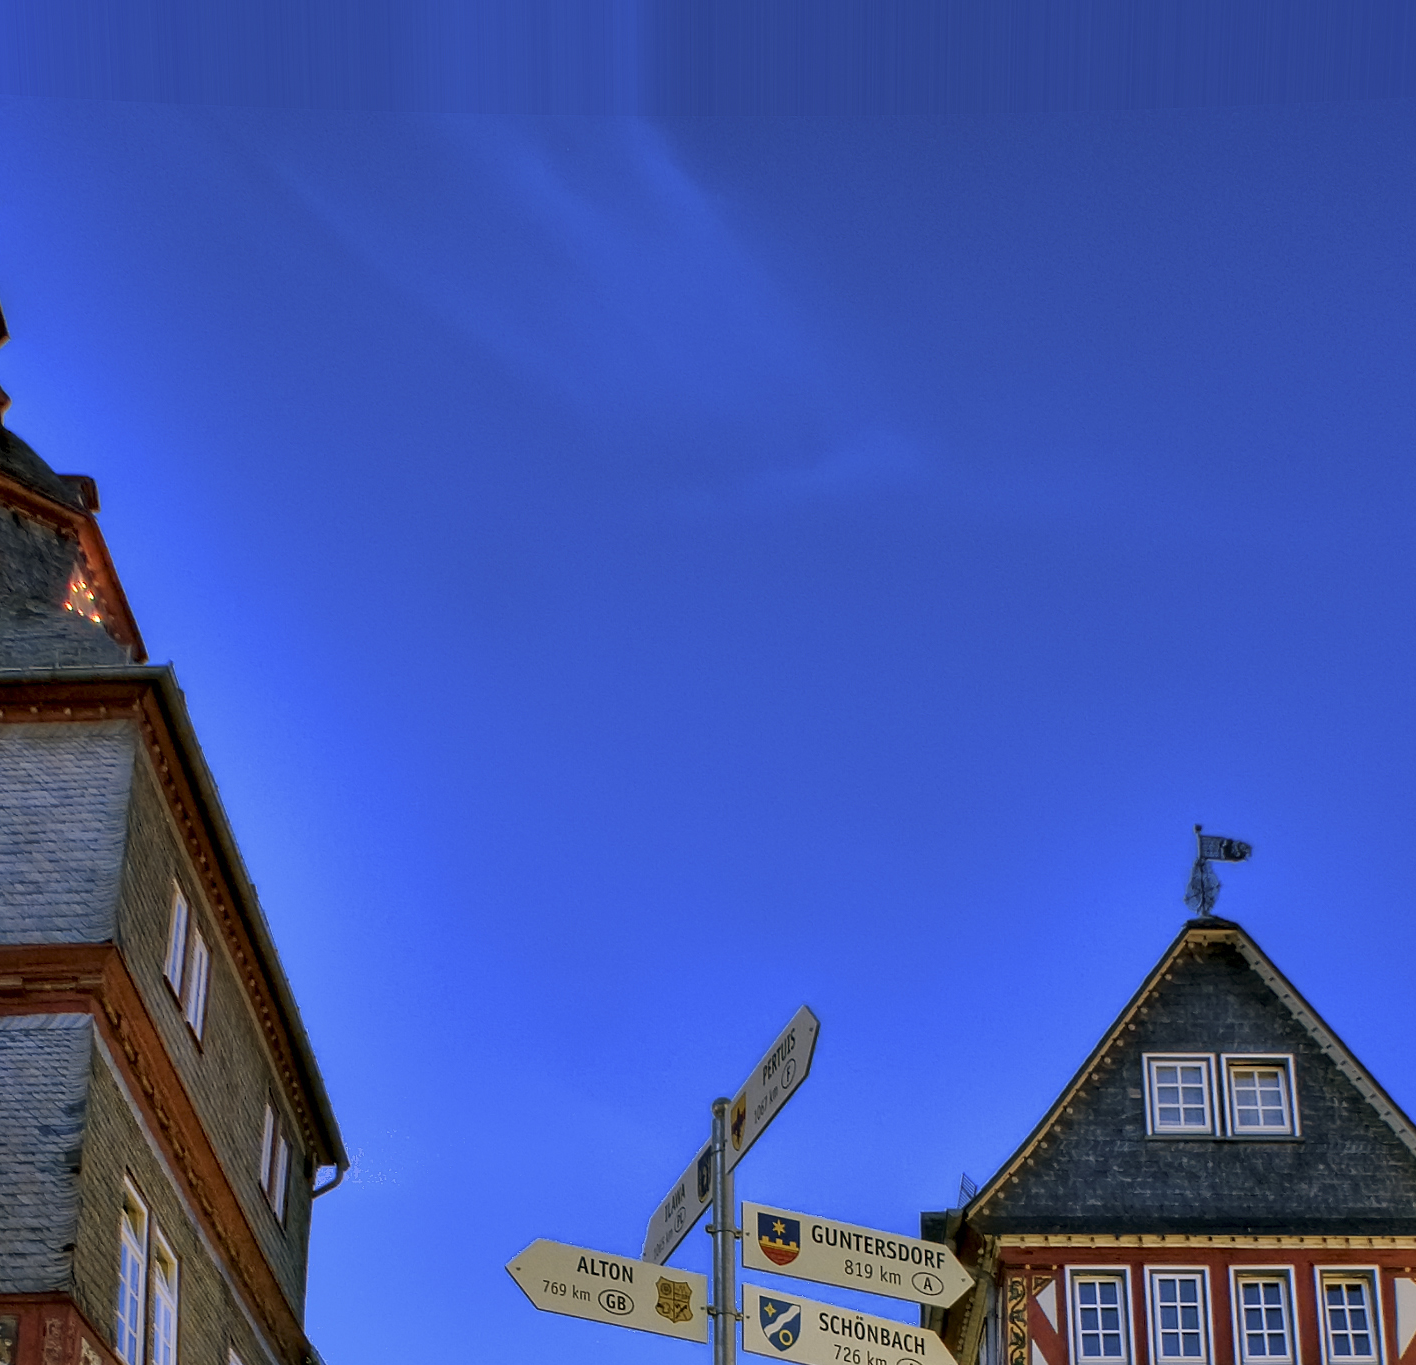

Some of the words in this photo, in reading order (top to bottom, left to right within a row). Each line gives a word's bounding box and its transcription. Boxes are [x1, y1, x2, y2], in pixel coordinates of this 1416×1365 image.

[762, 1027, 796, 1086] PERTUIS
[786, 1065, 791, 1082] F
[769, 1086, 779, 1104] km
[811, 1224, 945, 1269] GUNTERSDORF
[576, 1255, 633, 1284] ALTON
[844, 1259, 873, 1279] 819
[880, 1265, 901, 1286] km
[542, 1279, 567, 1297] 769
[572, 1284, 591, 1301] km
[922, 1277, 933, 1292] A
[605, 1293, 627, 1311] GB
[818, 1312, 925, 1355] SCHÖNBACH
[833, 1344, 861, 1365] 726
